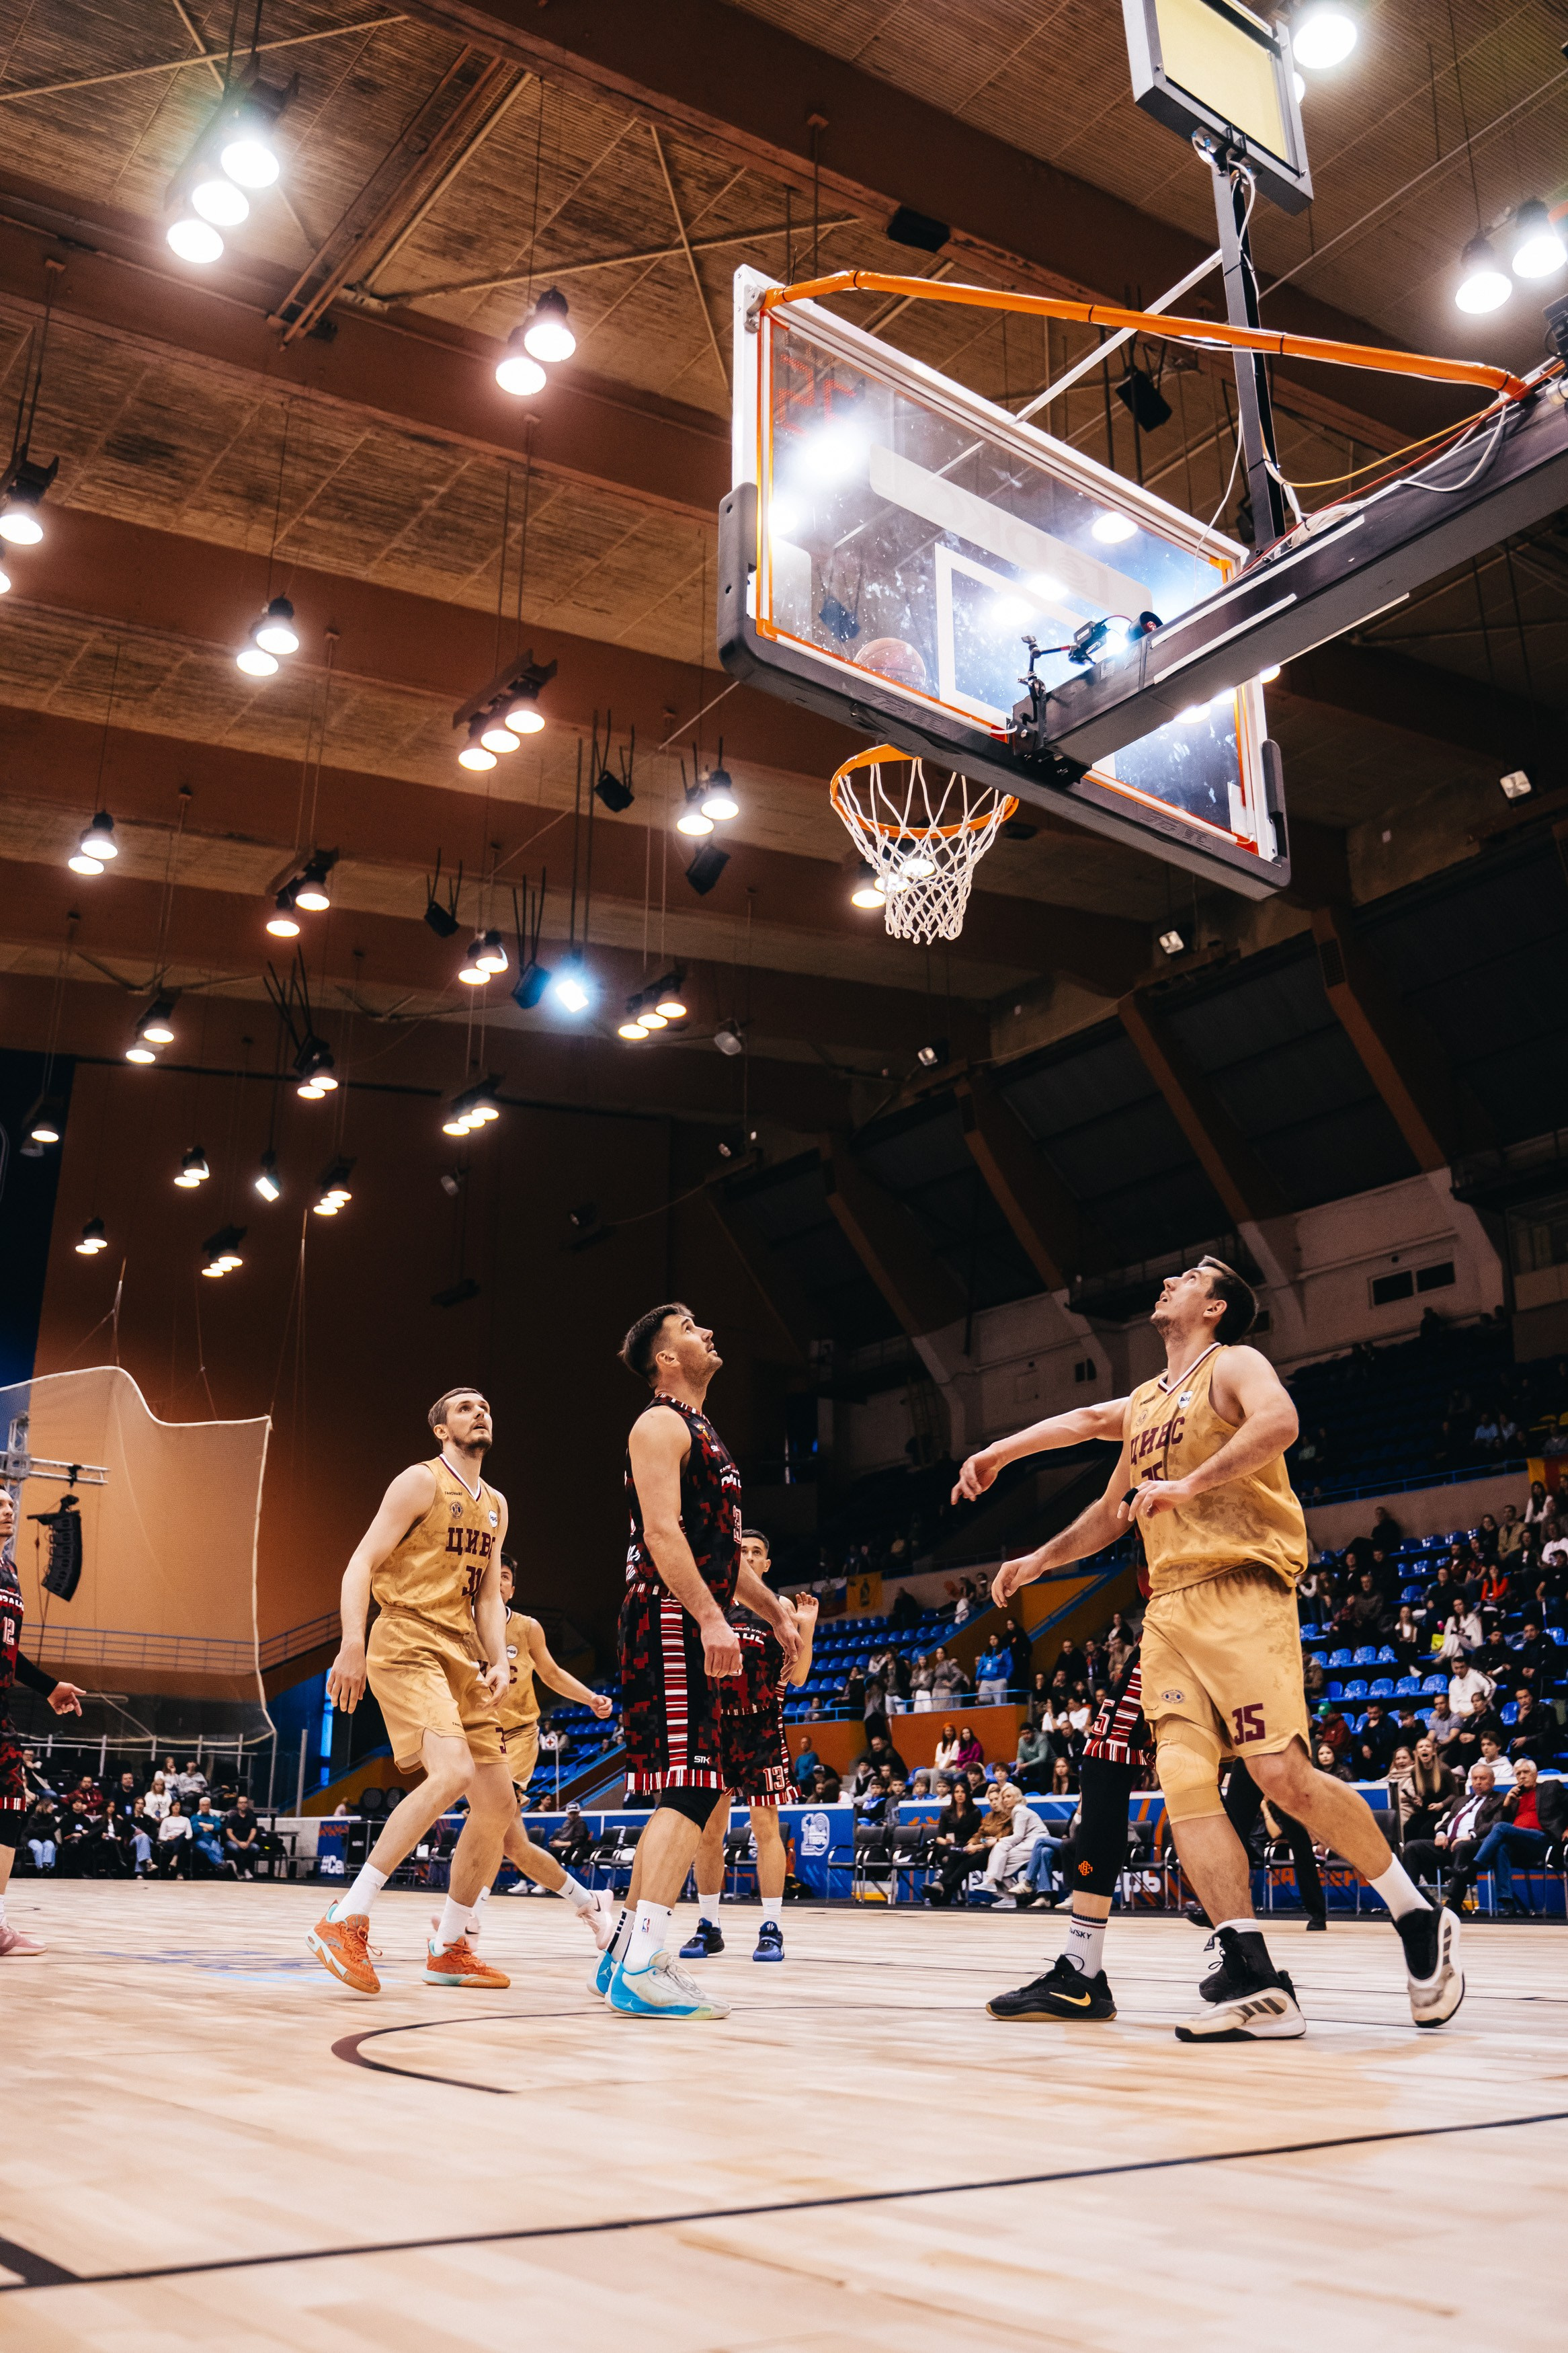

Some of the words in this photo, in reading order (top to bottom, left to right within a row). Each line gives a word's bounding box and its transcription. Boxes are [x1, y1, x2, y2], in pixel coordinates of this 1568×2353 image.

[3, 1616, 15, 1646] 12
[1232, 1703, 1266, 1746] 35
[694, 1755, 710, 1764] STK
[763, 1765, 785, 1792] 13
